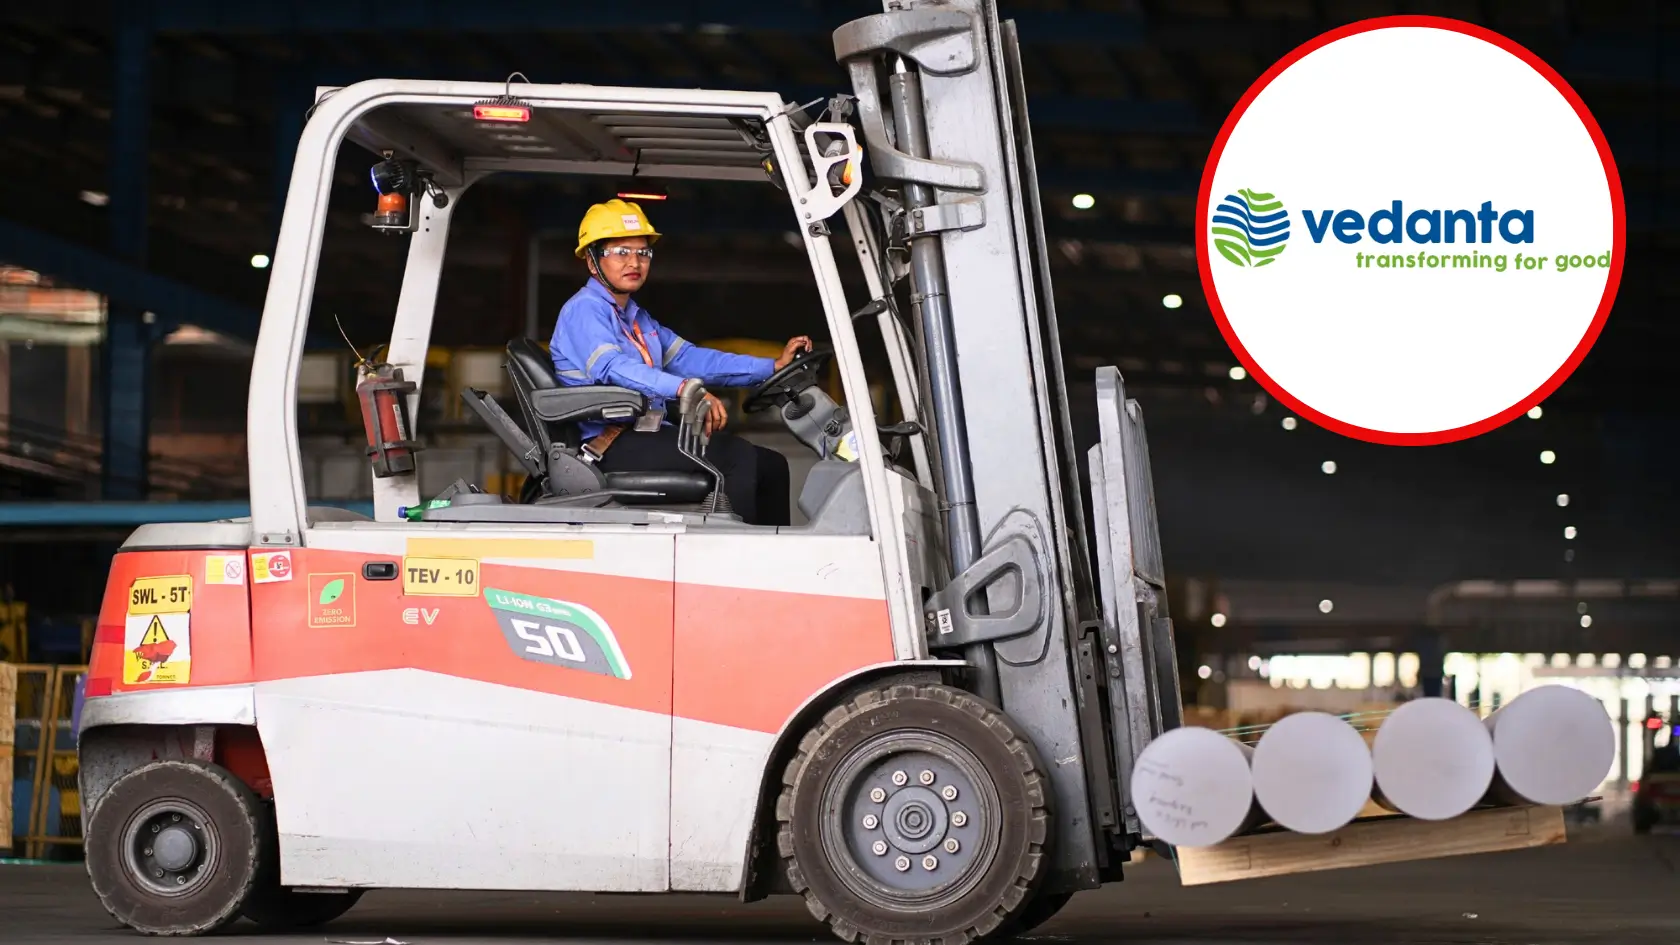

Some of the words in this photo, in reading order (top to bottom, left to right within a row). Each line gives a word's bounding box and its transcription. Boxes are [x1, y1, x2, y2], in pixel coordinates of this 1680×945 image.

[408, 568, 440, 583] TEV
[455, 569, 474, 585] 10
[132, 588, 158, 605] SWL
[170, 586, 188, 603] 5T
[314, 616, 351, 624] EMISSION
[322, 608, 343, 616] ZERO
[402, 607, 440, 625] EV
[510, 618, 587, 663] 50
